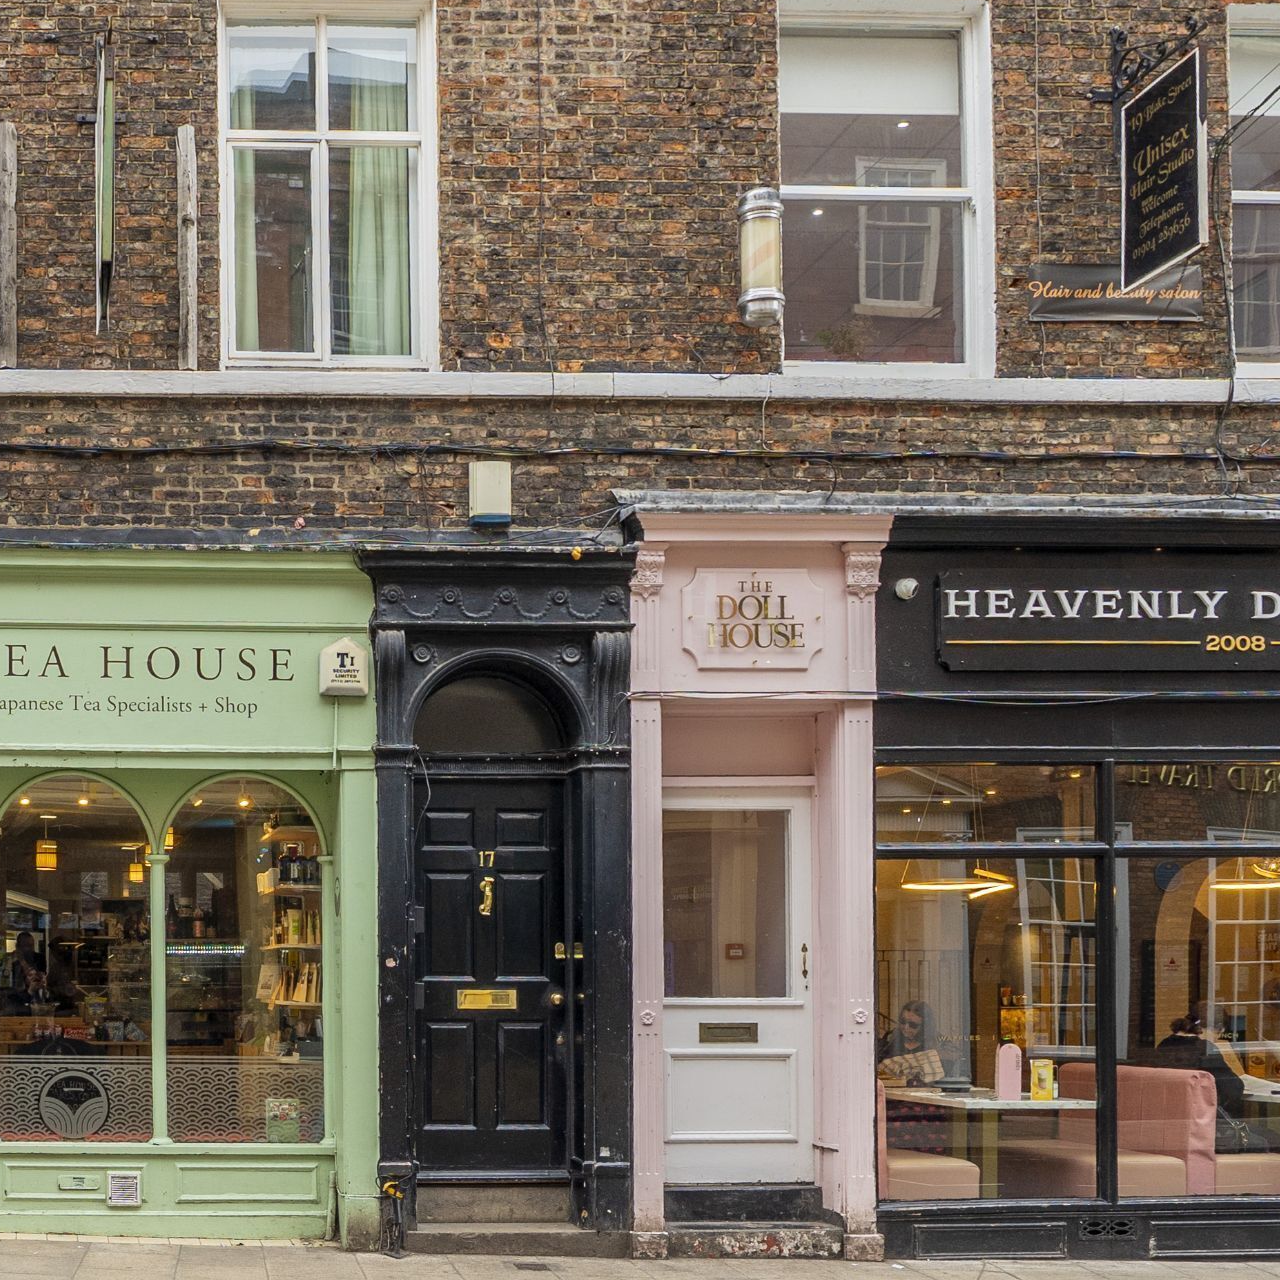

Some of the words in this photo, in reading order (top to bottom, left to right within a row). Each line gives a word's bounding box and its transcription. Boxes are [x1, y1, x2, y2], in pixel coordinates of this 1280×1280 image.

[1129, 114, 1143, 134] 19
[1144, 96, 1167, 120] Blake
[1167, 75, 1192, 104] Street
[1132, 122, 1190, 177] Unisex
[1129, 174, 1156, 201] Hair
[1157, 148, 1194, 185] Studio
[1132, 237, 1156, 260] 01904
[1028, 280, 1072, 299] Hair
[1073, 282, 1103, 299] and
[1159, 283, 1201, 300] salon
[738, 581, 773, 593] THE
[716, 595, 794, 621] DOLL
[944, 588, 1228, 620] HEAVENLY
[707, 623, 805, 649] HOUSE
[1205, 634, 1267, 652] 2008
[100, 645, 295, 682] HOUSE
[69, 694, 101, 712] Tea
[106, 695, 193, 717] Specialists
[214, 697, 258, 718] Shop
[478, 851, 495, 867] 17
